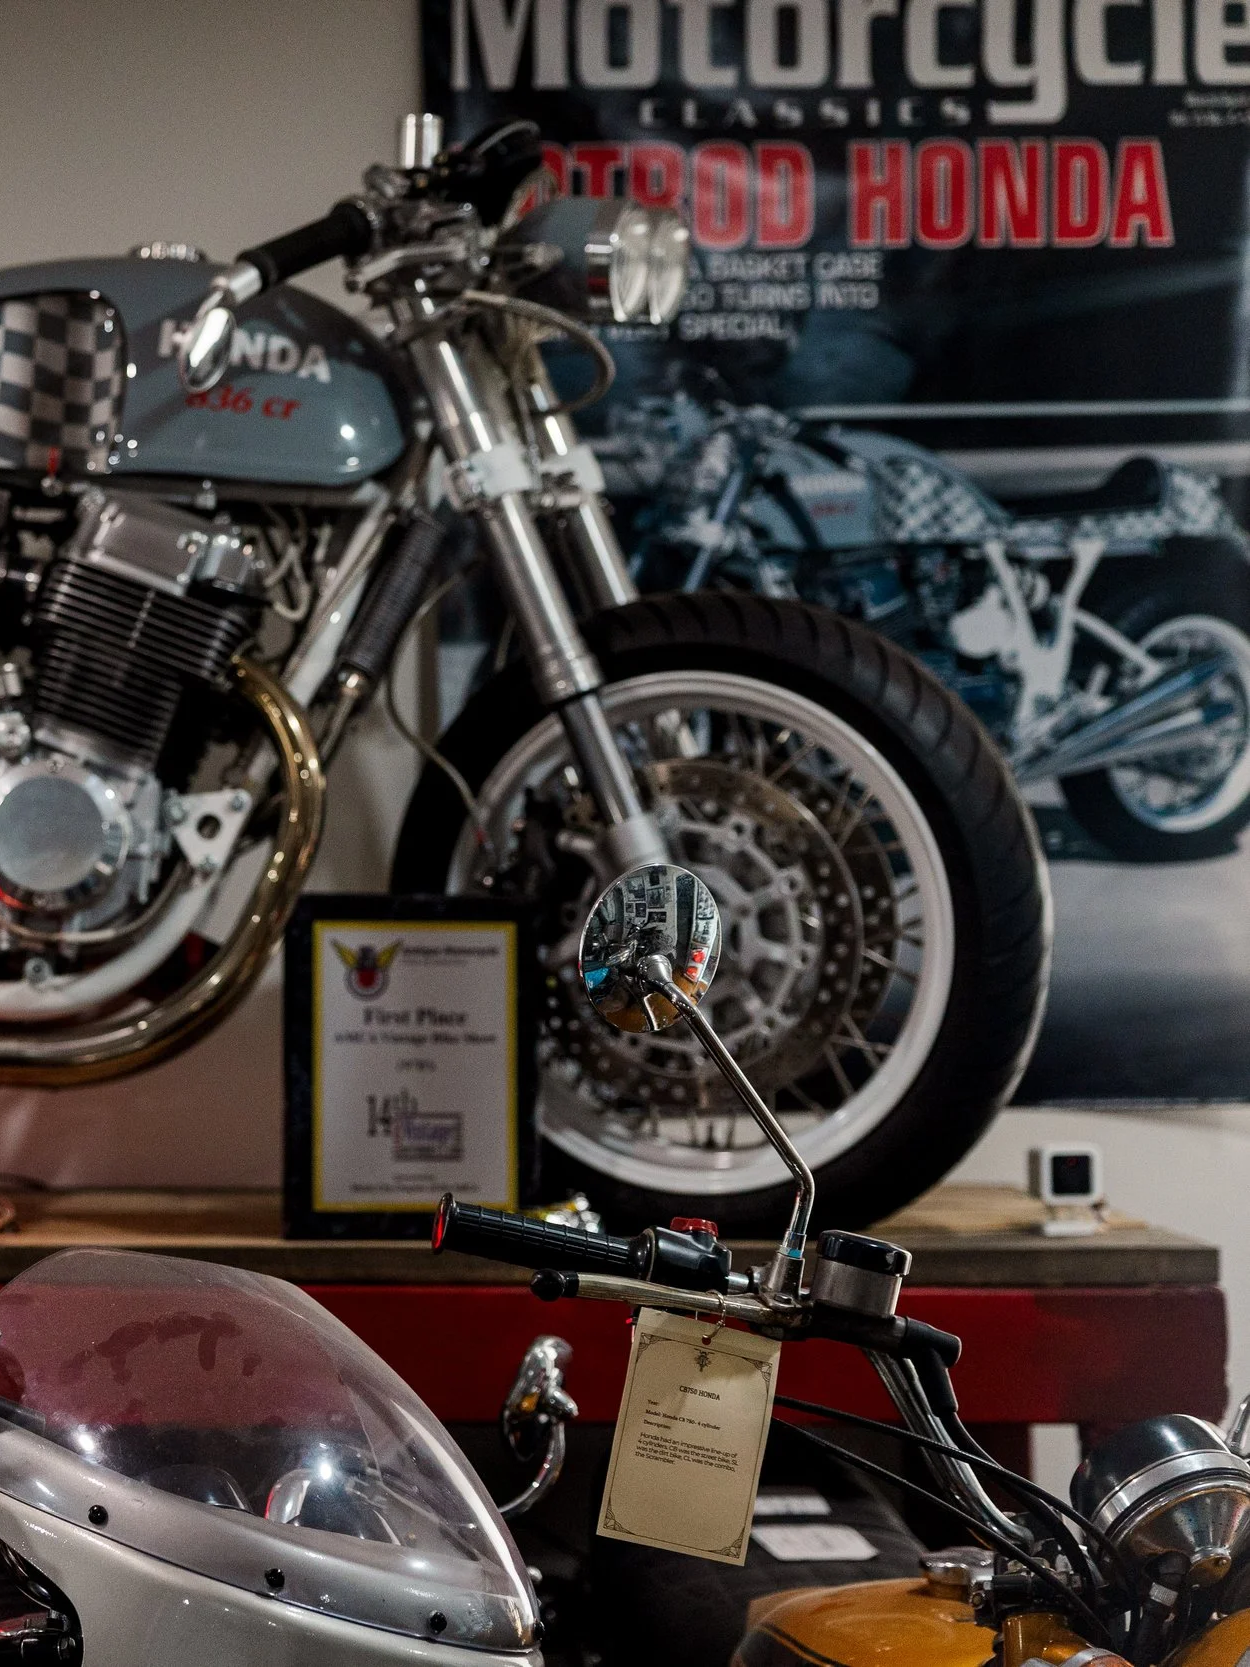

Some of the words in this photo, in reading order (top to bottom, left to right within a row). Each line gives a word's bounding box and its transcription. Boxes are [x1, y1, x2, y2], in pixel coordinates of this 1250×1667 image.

[450, 0, 1250, 124] Motorcycle
[637, 98, 972, 129] CLASSICS
[848, 138, 1175, 249] HONDA
[706, 252, 806, 282] BASKET
[812, 251, 884, 281] CASE
[720, 282, 811, 311] TURNS
[816, 281, 880, 310] INTO
[158, 318, 332, 384] HNDA
[679, 1385, 697, 1395] CB750
[698, 1390, 720, 1401] HONDA
[701, 1422, 720, 1430] cylinder
[640, 1432, 659, 1441] Honda
[680, 1441, 710, 1452] impressive
[711, 1448, 730, 1458] line-up
[701, 1453, 717, 1461] street
[704, 1459, 714, 1467] the
